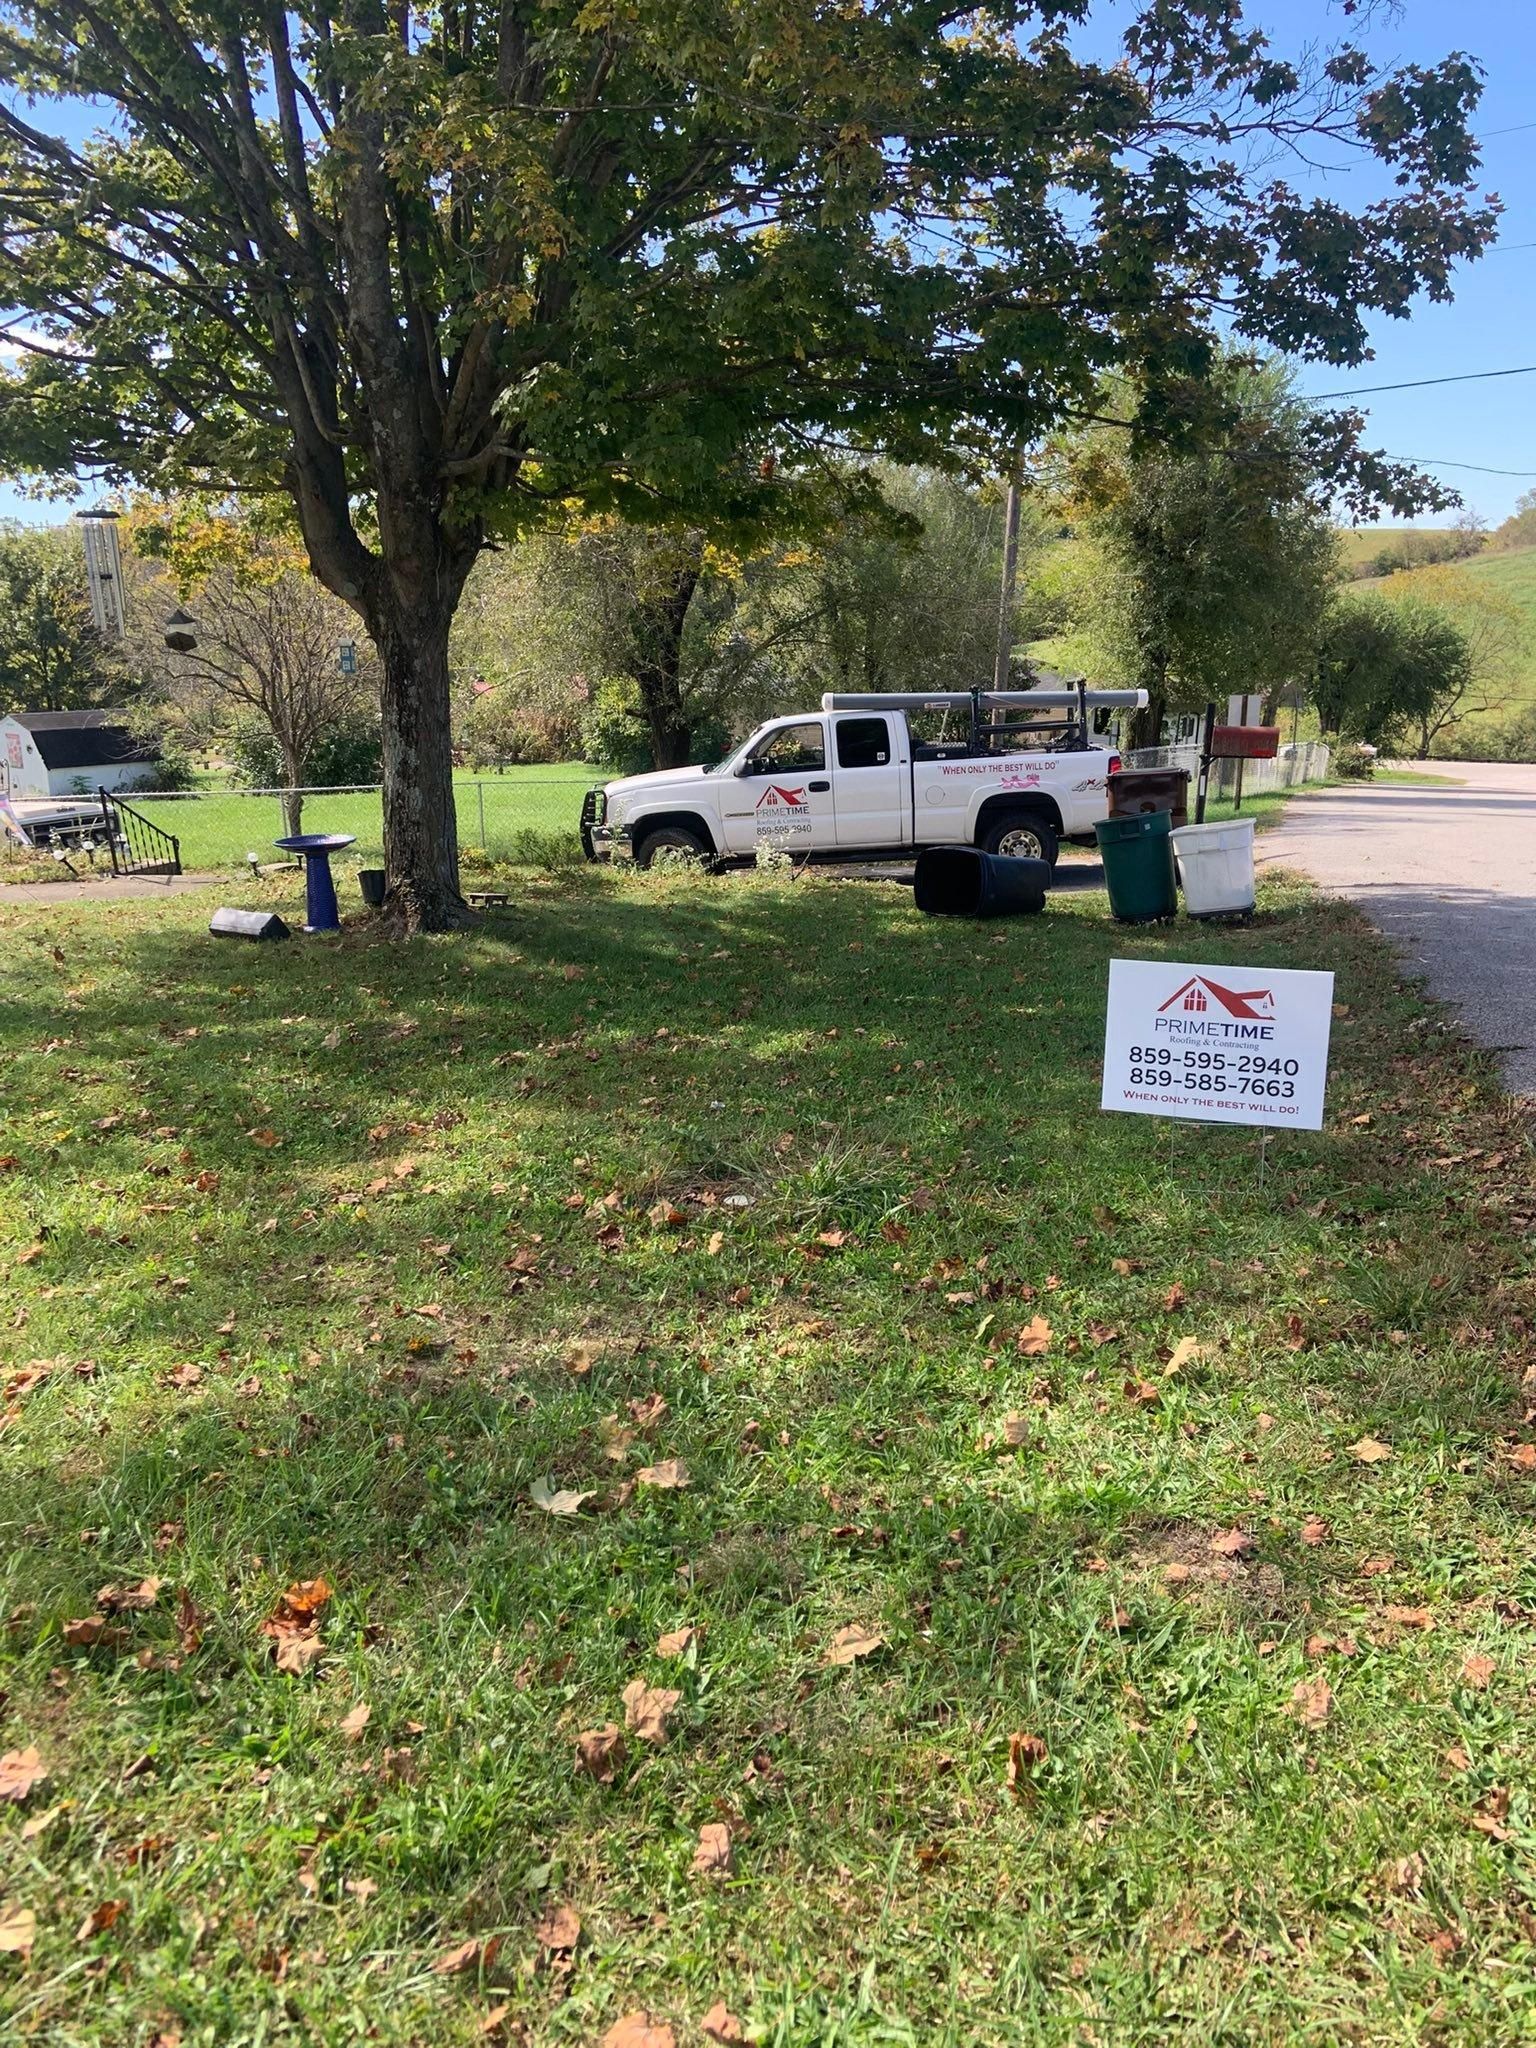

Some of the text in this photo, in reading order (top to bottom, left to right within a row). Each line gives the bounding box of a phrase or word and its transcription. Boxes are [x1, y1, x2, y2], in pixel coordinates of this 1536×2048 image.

[968, 765, 988, 774] ONLY
[989, 765, 1003, 773] THE
[1004, 763, 1023, 772] BEST
[1025, 762, 1043, 771] WILL
[756, 806, 810, 817] PRIMETIME
[1154, 1018, 1275, 1041] PRIMETIME
[1169, 1035, 1260, 1052] Roofing & Contracting
[1129, 1046, 1299, 1076] 859-595-2940
[1129, 1067, 1295, 1098] 859-585-7663
[1123, 1090, 1300, 1115] WHEN ONLY THE BEST WILL DO!
